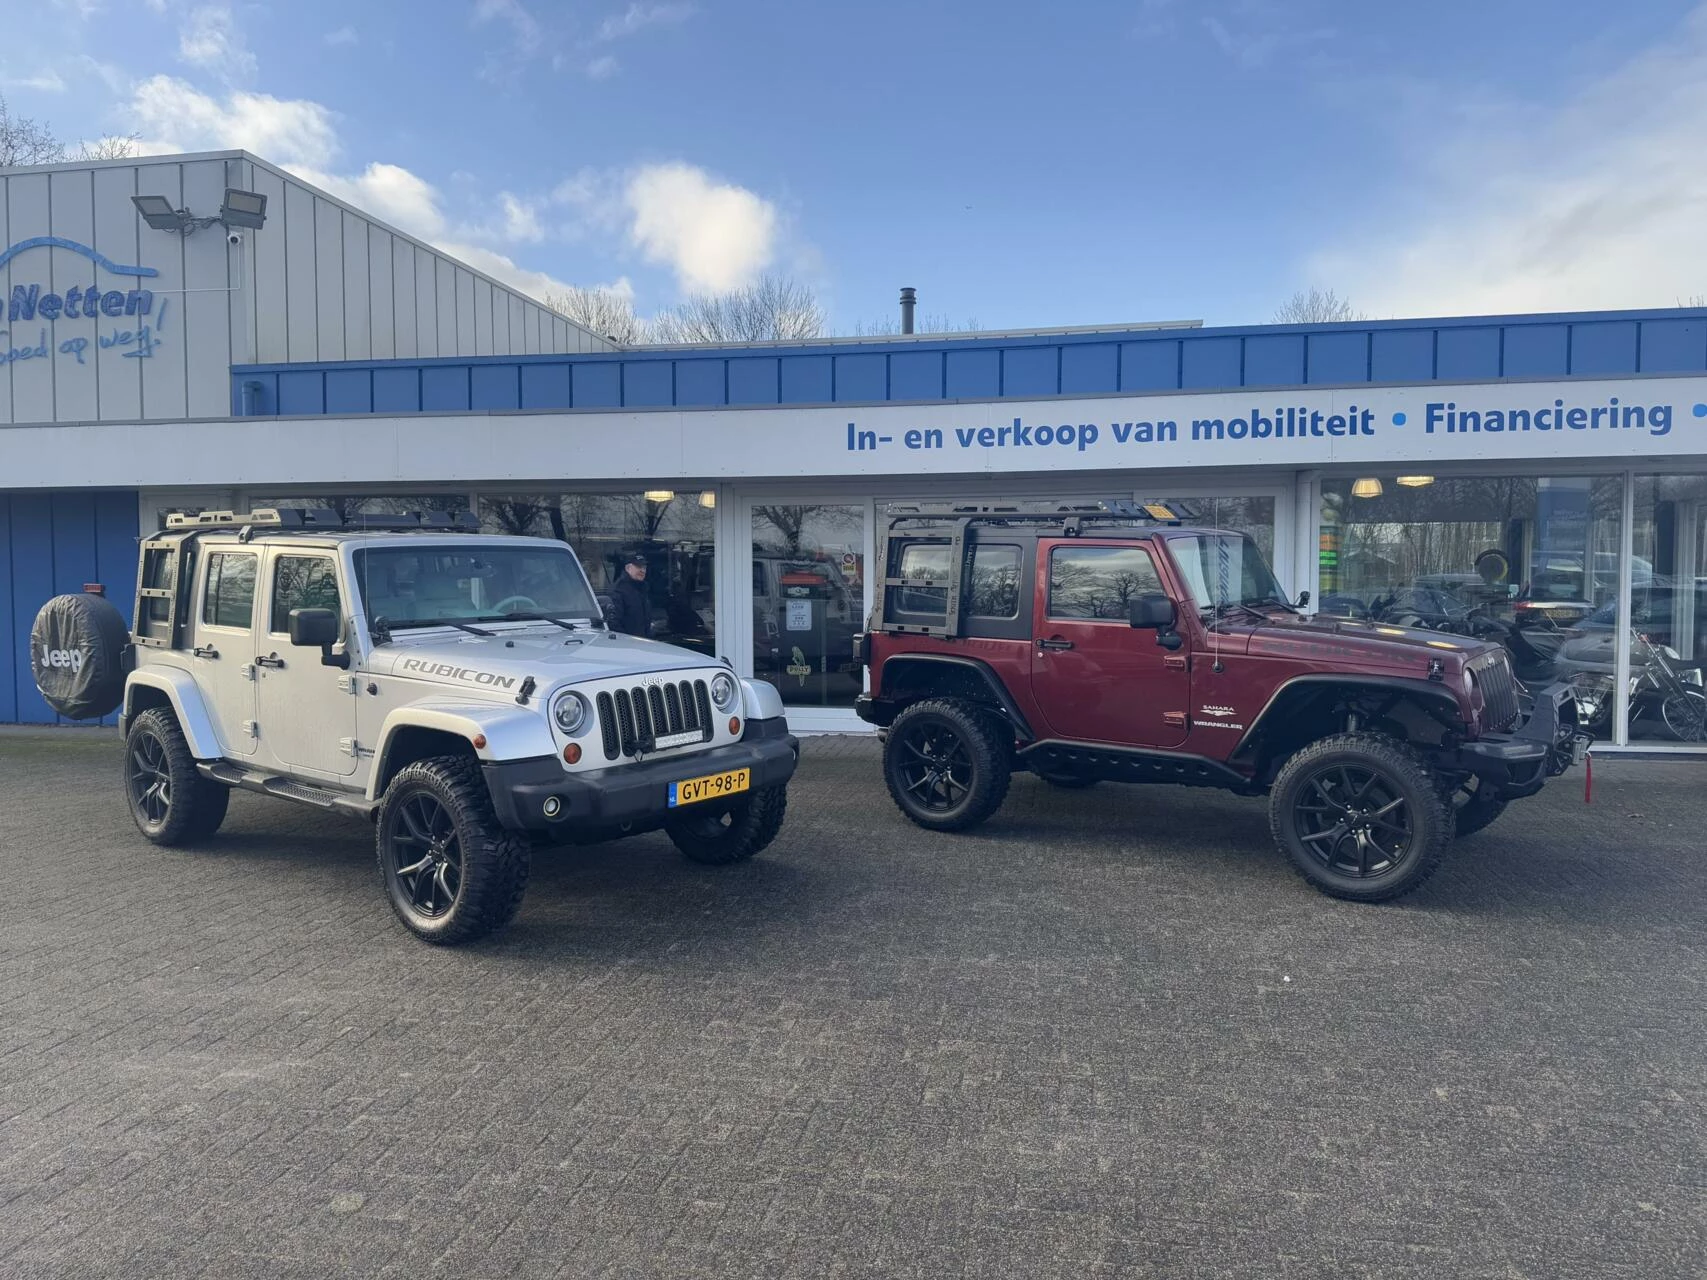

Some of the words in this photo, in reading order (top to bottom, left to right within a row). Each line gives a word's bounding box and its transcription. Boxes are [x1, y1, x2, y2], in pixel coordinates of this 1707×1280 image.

[8, 284, 153, 321] Netten
[848, 422, 893, 450] In-
[904, 429, 943, 449] en
[955, 418, 1099, 451] verkoop
[1111, 420, 1178, 443] van
[1191, 405, 1375, 440] mobiliteit
[1425, 397, 1673, 436] Financiering
[41, 644, 82, 673] Jeep
[403, 658, 516, 689] RUBICON
[1202, 704, 1235, 712] SAHARA
[1193, 720, 1243, 730] WRANGLER
[682, 772, 746, 800] GVT-98-P
